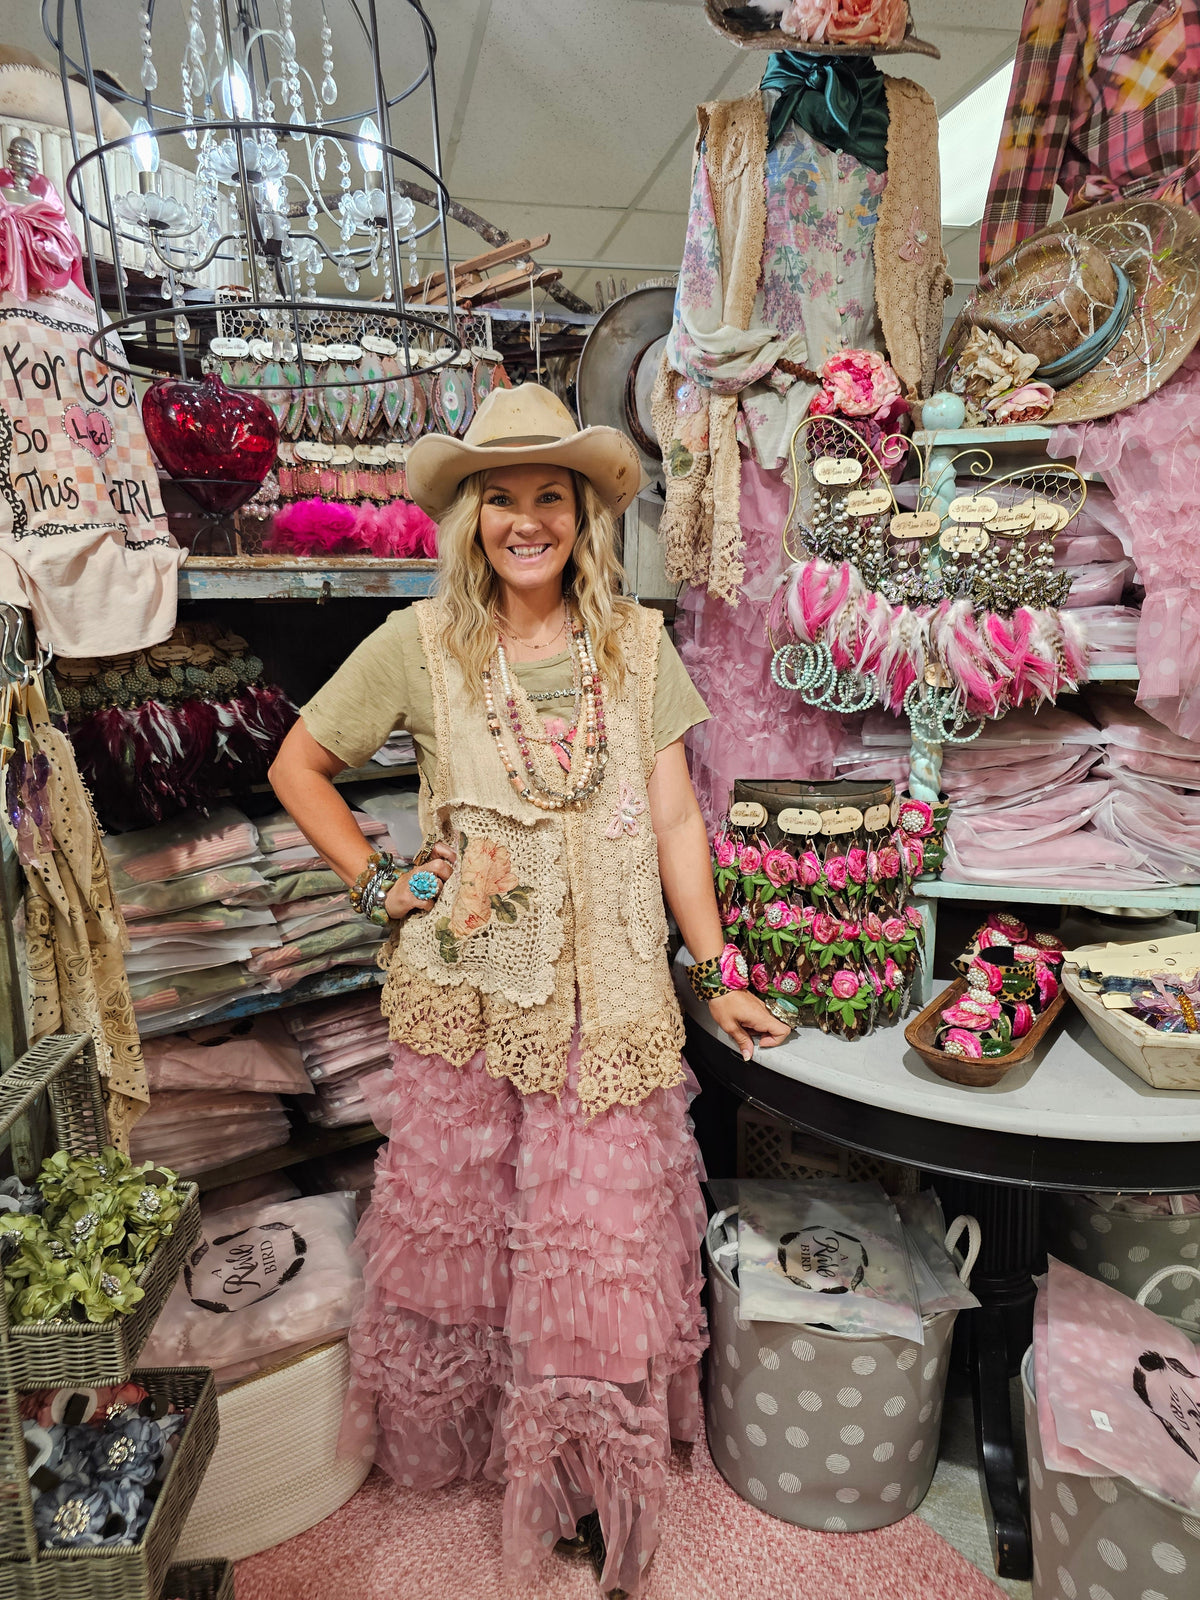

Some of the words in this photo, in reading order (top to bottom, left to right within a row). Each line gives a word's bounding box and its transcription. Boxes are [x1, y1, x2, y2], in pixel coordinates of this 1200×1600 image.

[3, 341, 66, 401] For
[13, 419, 48, 456] So
[14, 466, 79, 513] This
[259, 1240, 278, 1276] BIRD
[800, 1243, 812, 1273] BIRD
